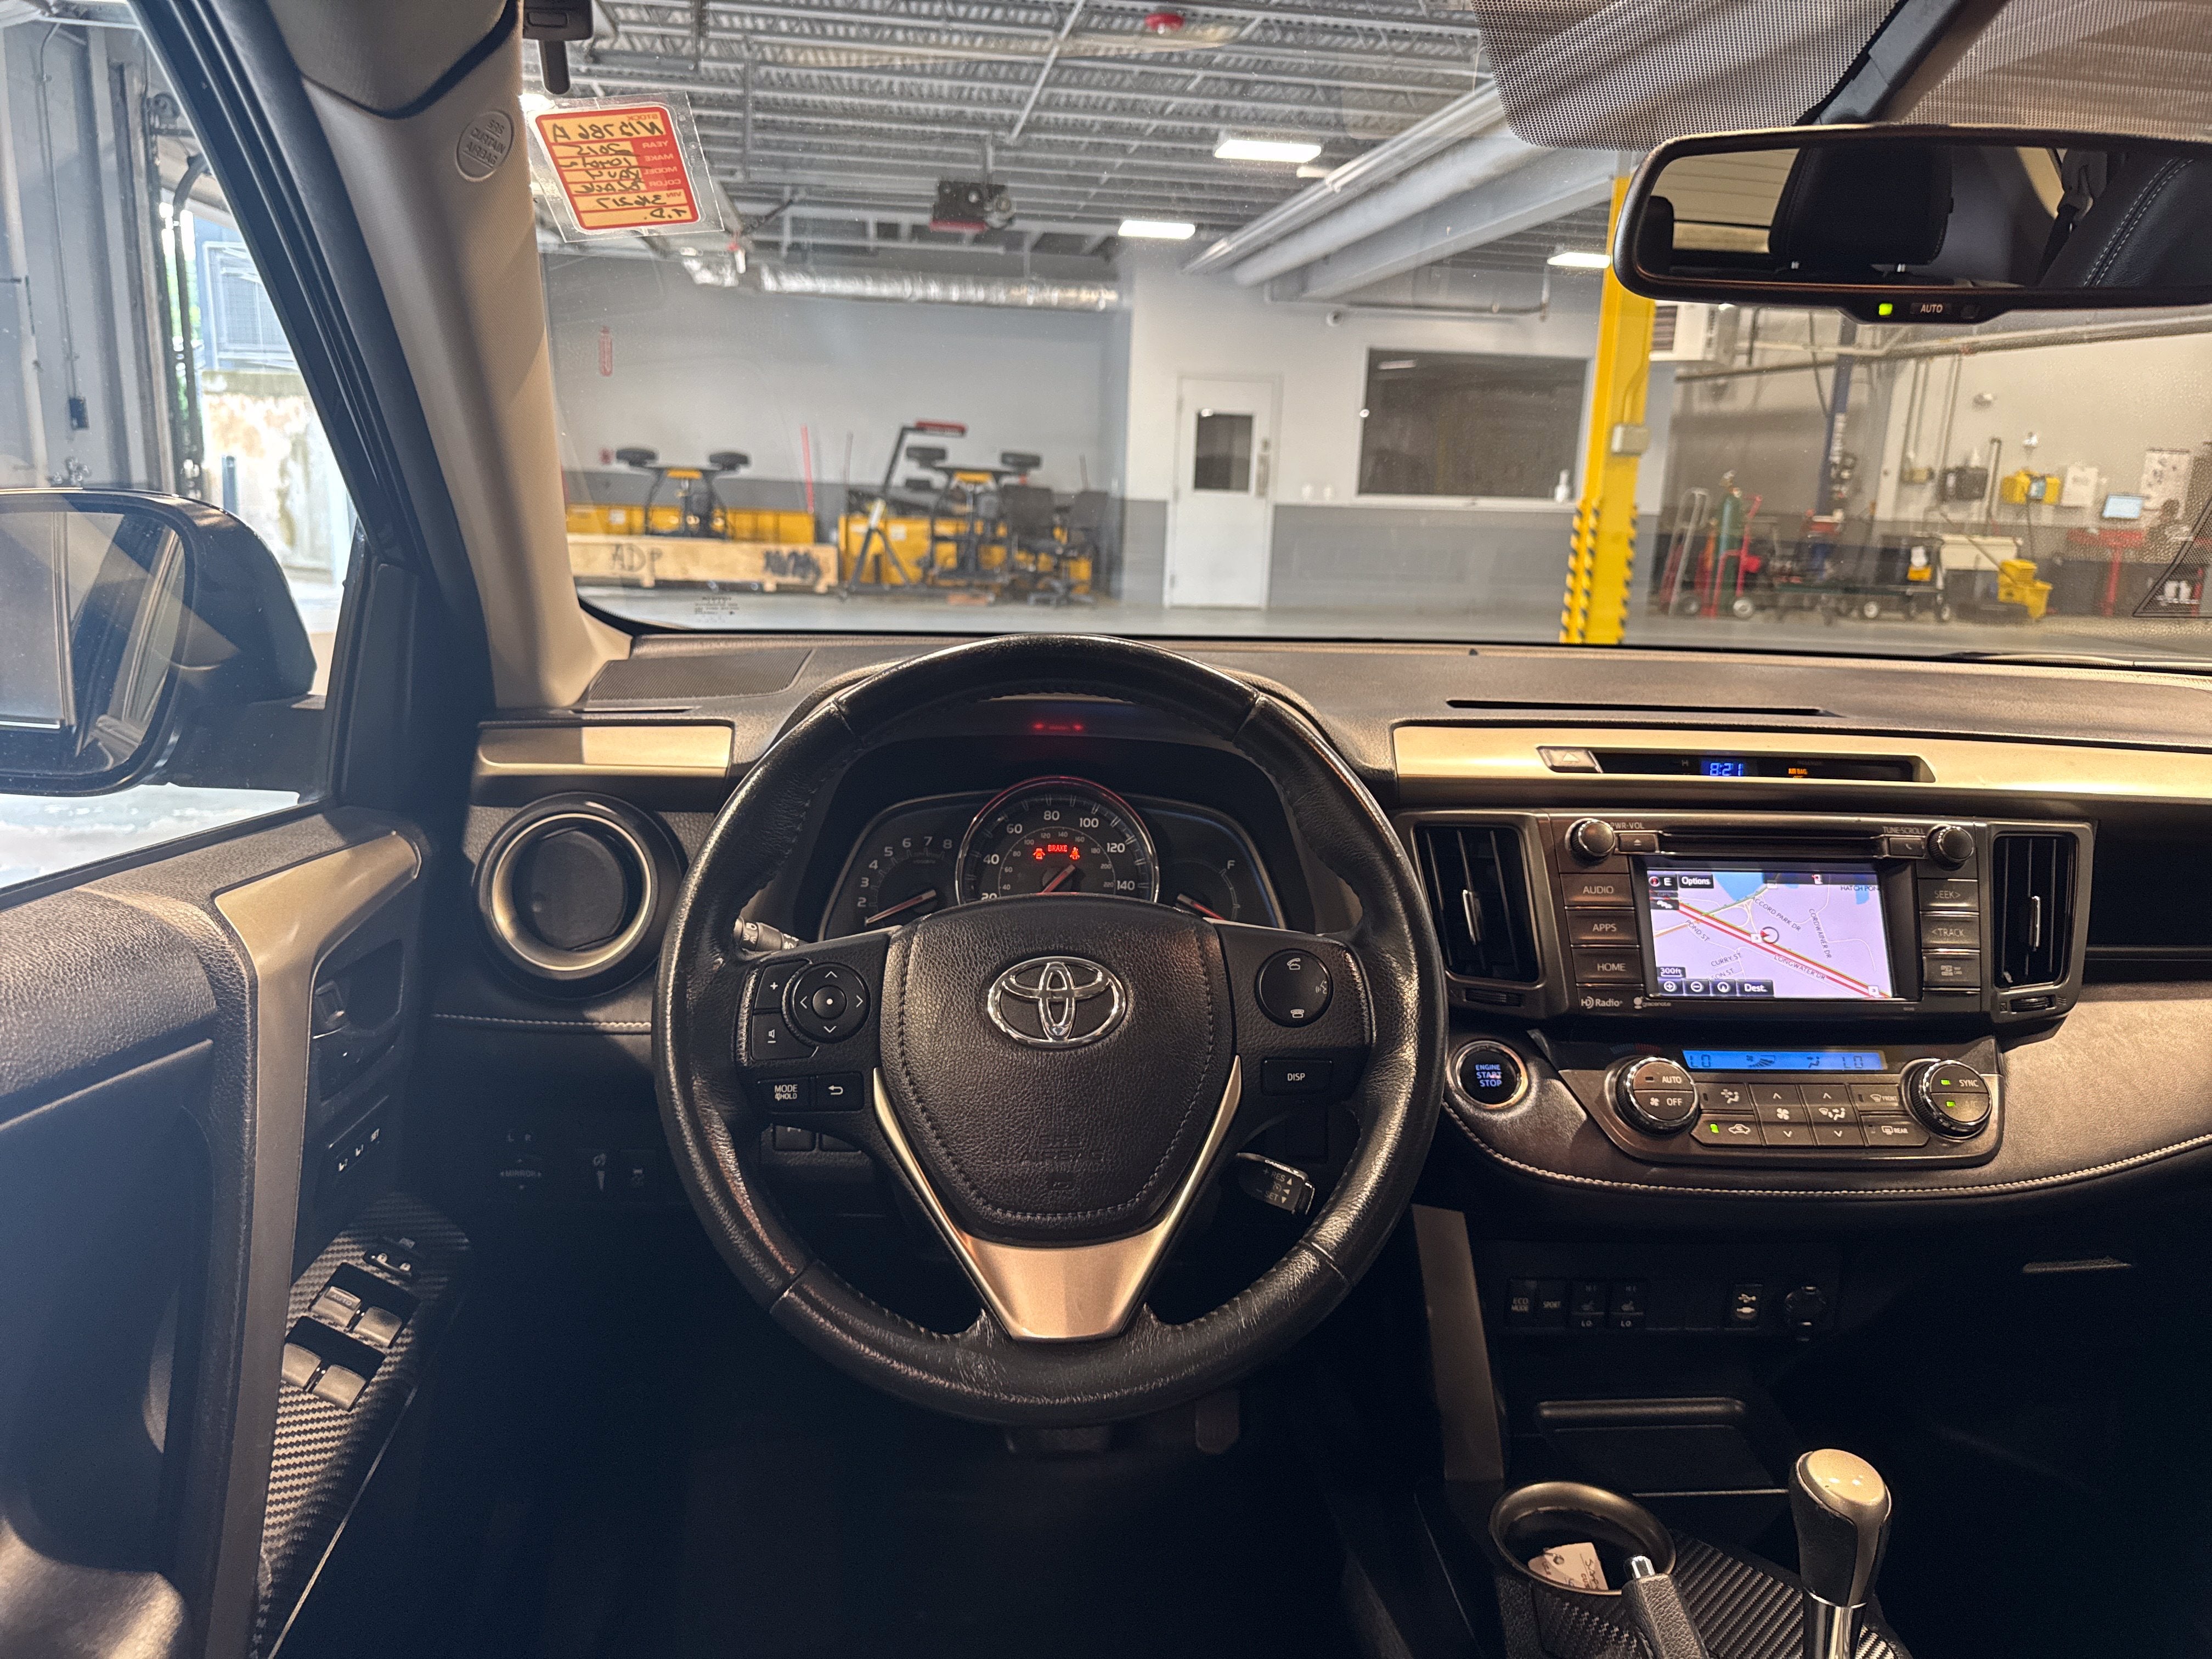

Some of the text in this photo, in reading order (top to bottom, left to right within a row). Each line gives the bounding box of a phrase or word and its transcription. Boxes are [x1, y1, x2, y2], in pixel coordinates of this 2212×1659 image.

[471, 127, 506, 155] CURTAIN
[466, 142, 498, 165] AIRBAG
[1920, 304, 1943, 313] AUTO
[1709, 762, 1743, 776] 8:21
[1043, 810, 1060, 821] 80
[1079, 817, 1099, 828] 100
[1006, 823, 1023, 834] 60
[902, 838, 912, 848] 6
[924, 836, 933, 846] 7
[943, 839, 952, 849] 8
[884, 847, 894, 857] 5
[1047, 844, 1068, 853] BRAKE
[1107, 843, 1125, 853] 120
[983, 854, 1000, 865] 40
[868, 860, 878, 870] 4
[1227, 860, 1235, 870] F
[860, 877, 870, 888] 3
[1117, 881, 1135, 891] 140
[1664, 878, 1673, 886] E
[1681, 876, 1710, 886] Options
[1583, 885, 1614, 894] AUDIO
[857, 897, 867, 907] 2
[1752, 896, 1802, 932] ACCORD PARK DR
[1592, 923, 1617, 932] APPS
[1685, 919, 1710, 942] POND ST
[1823, 949, 1832, 959] DR
[1711, 955, 1733, 966] CURRY
[1597, 963, 1626, 972] HOME
[1774, 953, 1826, 980] LONGWATER DR
[1744, 983, 1768, 992] Dest.
[1287, 1073, 1306, 1081] DISP
[1662, 1076, 1682, 1084] AUTO
[1959, 1079, 1979, 1087] SYNC
[774, 1084, 798, 1093] MODE
[1666, 1098, 1683, 1106] OFF
[1265, 1159, 1292, 1173] CANCEL
[1271, 1171, 1286, 1182] RES
[1265, 1190, 1279, 1201] SET
